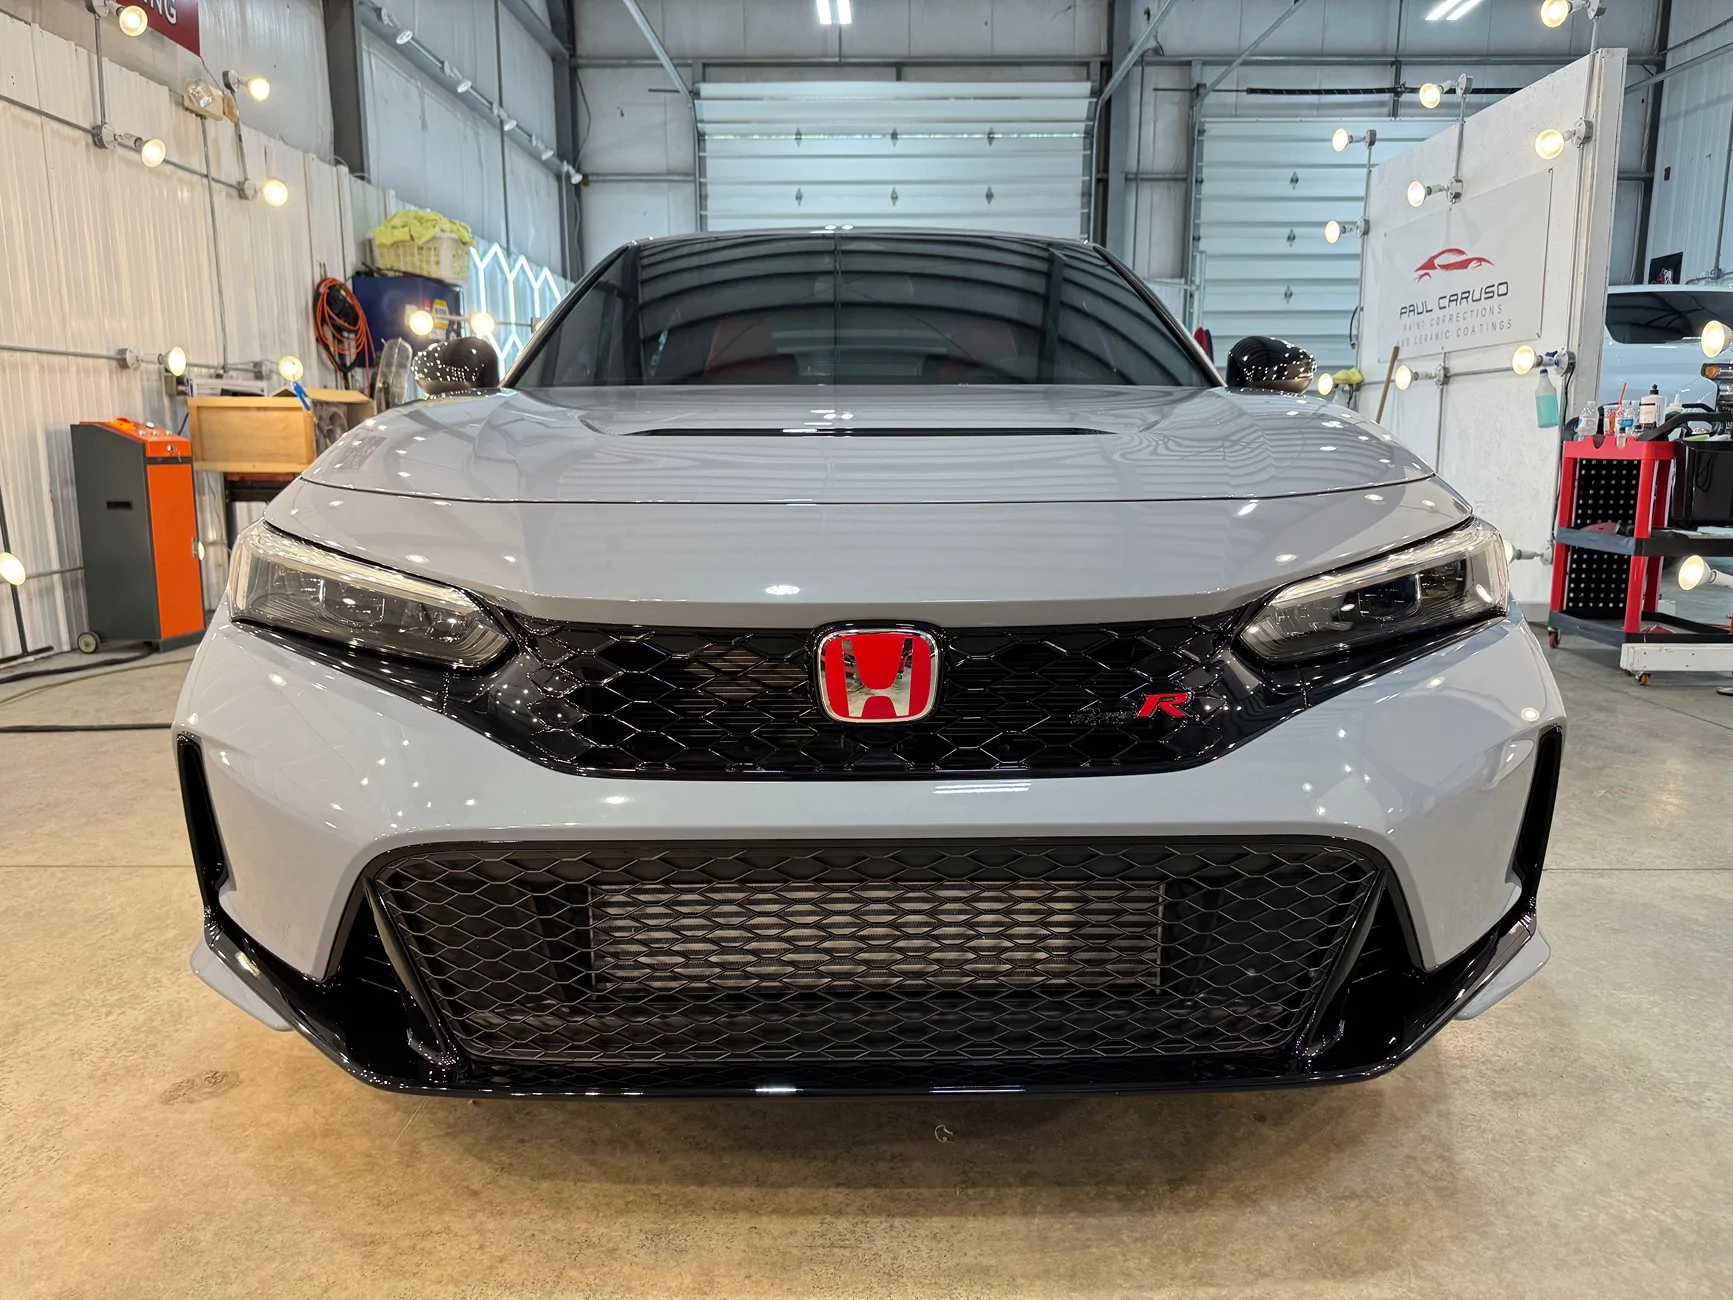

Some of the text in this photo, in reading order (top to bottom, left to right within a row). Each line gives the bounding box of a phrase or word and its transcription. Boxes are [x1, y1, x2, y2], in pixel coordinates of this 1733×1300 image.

[1399, 281, 1509, 319] PAUL CARUSO
[1403, 304, 1502, 331] PAINT CORRECTIONS
[1414, 330, 1450, 345] CERAMIC
[1456, 319, 1512, 337] COATINGS
